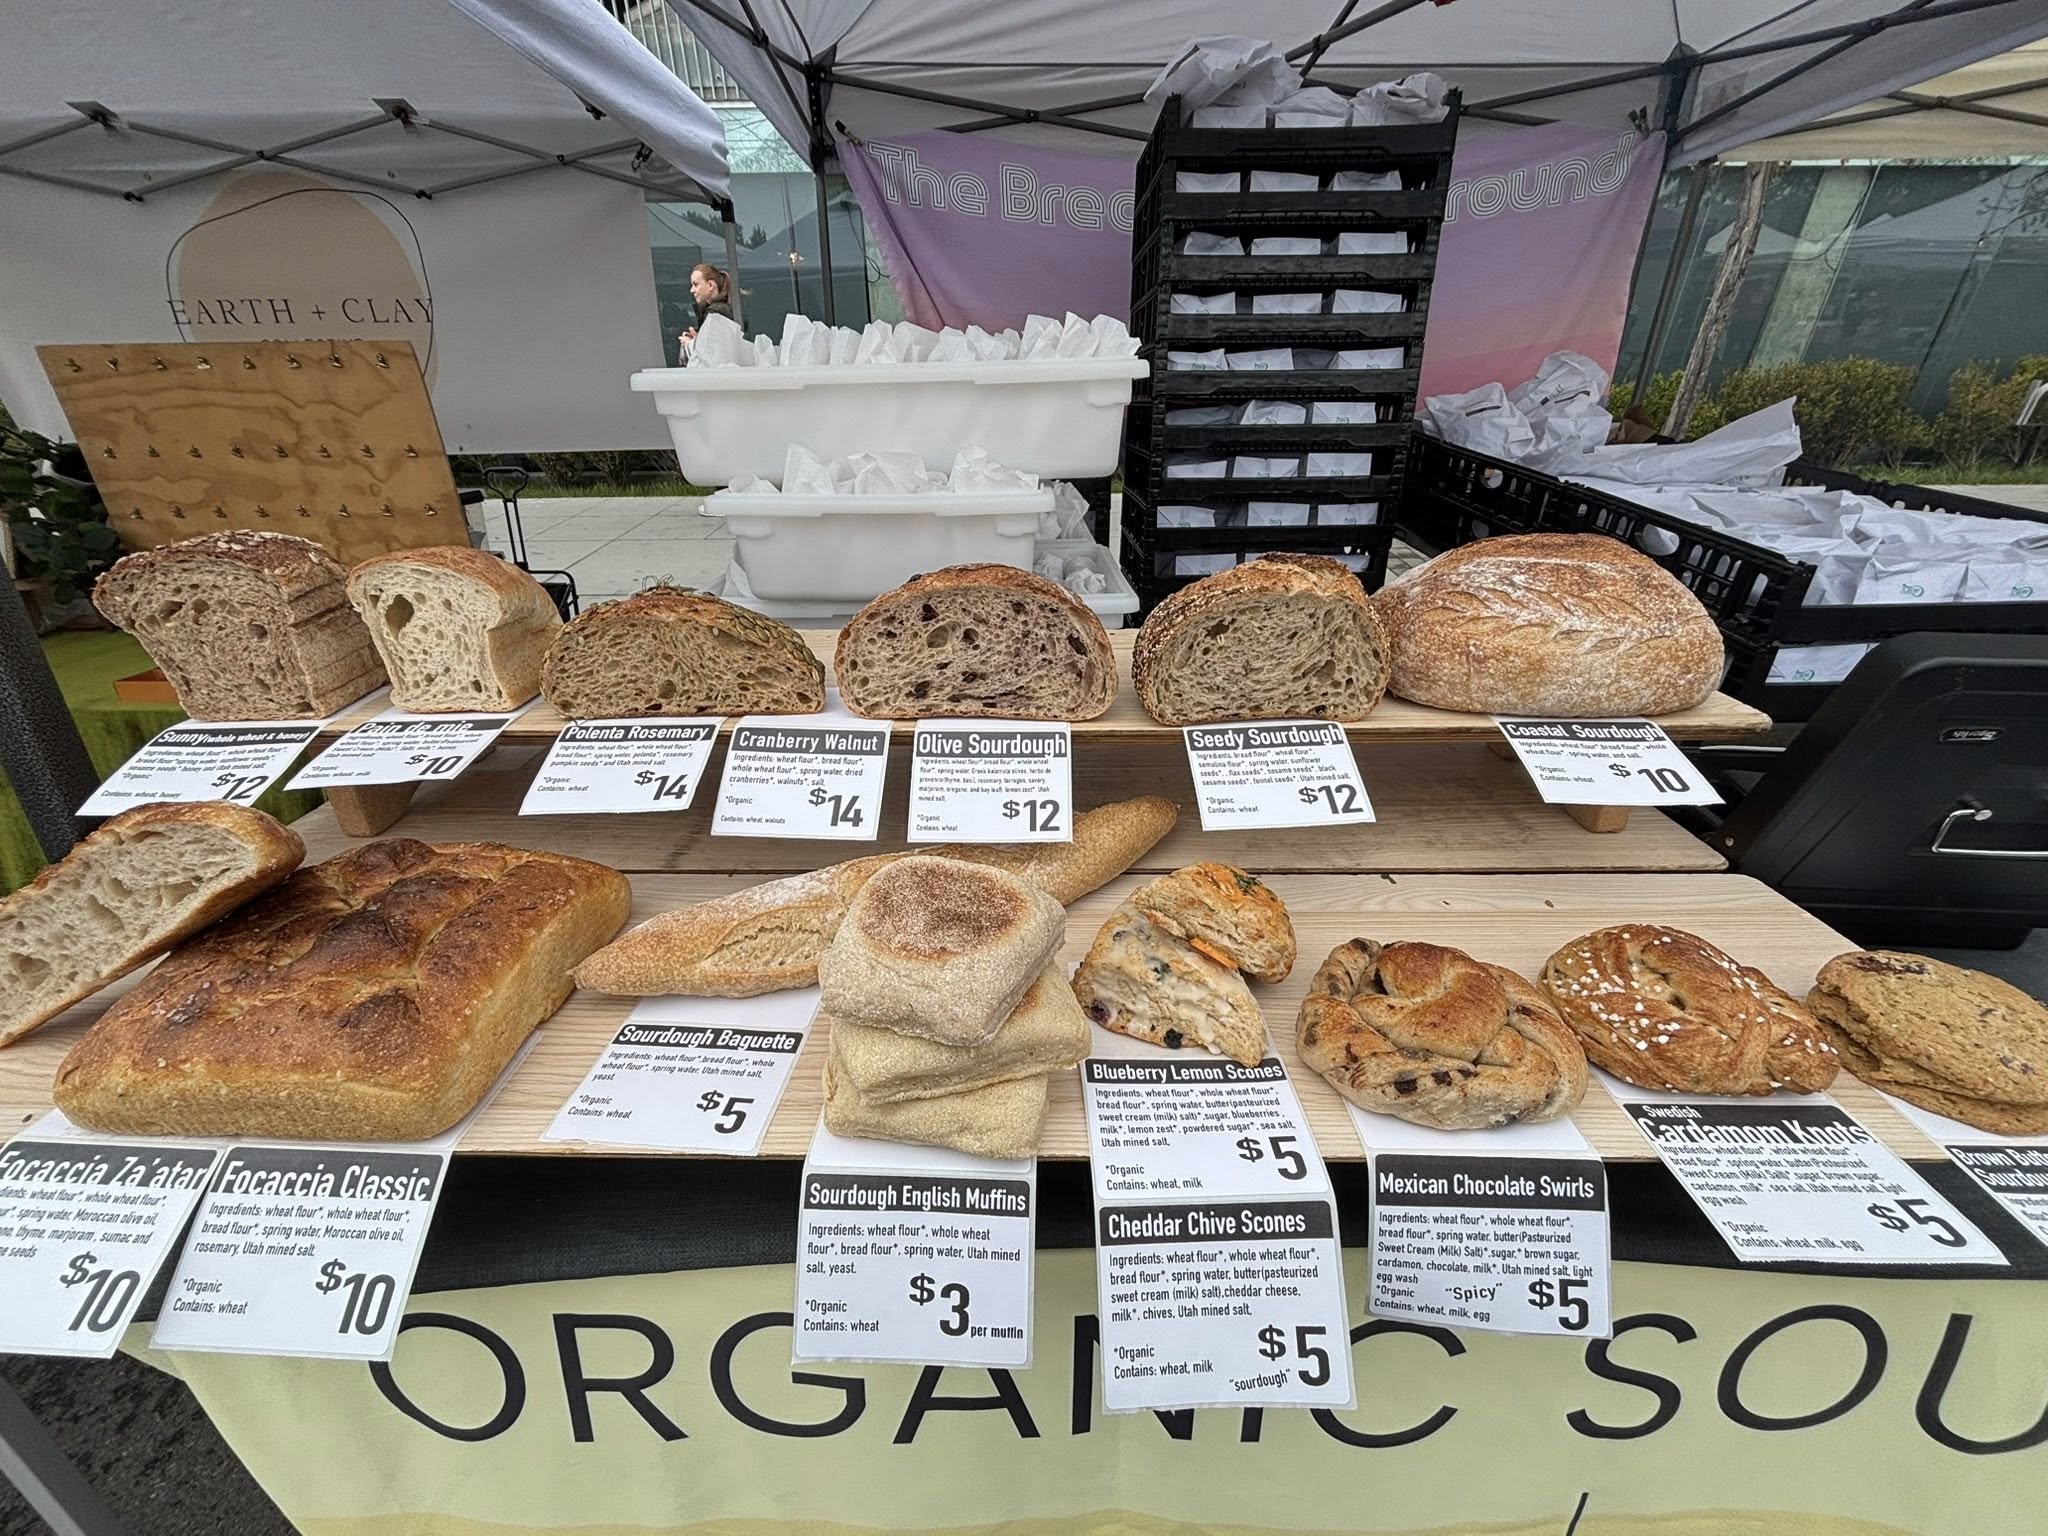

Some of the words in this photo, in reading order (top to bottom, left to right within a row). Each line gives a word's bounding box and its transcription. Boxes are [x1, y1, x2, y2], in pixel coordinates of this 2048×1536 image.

[867, 141, 988, 216] The
[168, 300, 295, 325] EARTH
[312, 304, 325, 320] +
[341, 298, 432, 324] CLAY
[237, 733, 264, 741] wheat
[357, 722, 402, 733] Pain
[406, 720, 428, 732] de
[438, 721, 474, 731] mie
[565, 727, 623, 739] Polenta
[628, 726, 709, 741] Rosemary
[1193, 730, 1244, 749] Seedy
[1250, 725, 1342, 745] Sourdough
[1506, 723, 1569, 738] Coastal
[1575, 725, 1665, 741] Sourdough
[739, 731, 819, 752] Cranberry
[825, 734, 878, 750] Walnut
[919, 734, 963, 754] Olive
[968, 734, 1065, 758] Sourdough
[405, 754, 464, 776] $10
[212, 773, 269, 800] $12
[634, 770, 688, 800] $14
[808, 787, 863, 827] $14
[1299, 784, 1364, 815] $12
[1002, 800, 1060, 832] $12
[619, 1026, 713, 1048] Sourdough
[717, 1030, 796, 1051] Baguette
[1093, 1063, 1167, 1083] Blueberry
[1170, 1065, 1223, 1080] Lemon
[1228, 1064, 1283, 1079] Scones
[568, 1106, 605, 1117] Contains:
[606, 1110, 632, 1119] wheat
[696, 1089, 755, 1134] $5
[1643, 1106, 1702, 1118] Swedish
[1638, 1117, 1787, 1144] Cardamom
[1781, 1119, 1873, 1144] Knots
[0, 1151, 108, 1185] Focaccia
[1236, 1135, 1308, 1181] $5
[1950, 1148, 2016, 1166] Brown
[221, 1160, 334, 1198] Focaccia
[340, 1165, 430, 1200] Classic
[1107, 1180, 1148, 1191] Contains:
[1150, 1178, 1181, 1189] wheat,
[1183, 1178, 1203, 1188] milk
[1380, 1173, 1448, 1194] Mexican
[1453, 1174, 1536, 1196] Chocolate
[1540, 1176, 1595, 1198] Swirls
[810, 1183, 896, 1210] Sourdough
[902, 1185, 960, 1211] English
[966, 1188, 1026, 1211] Muffins
[1108, 1213, 1182, 1239] Cheddar
[1188, 1211, 1236, 1234] Chive
[1241, 1210, 1306, 1233] Scones
[1380, 1212, 1430, 1225] Ingredients:
[1433, 1213, 1458, 1224] wheat
[1490, 1215, 1515, 1226] whole
[1518, 1215, 1543, 1227] wheat
[1867, 1199, 1967, 1248] $5
[808, 1223, 864, 1238] Ingredients:
[868, 1225, 896, 1236] wheat
[931, 1226, 959, 1239] whole
[962, 1228, 990, 1240] wheat
[1379, 1228, 1403, 1238] bread
[1436, 1231, 1463, 1243] spring
[841, 1243, 868, 1255] bread
[904, 1244, 933, 1259] spring
[937, 1246, 965, 1259] water,
[967, 1247, 988, 1259] Utah
[991, 1248, 1020, 1261] mined
[1110, 1254, 1164, 1268] Ingredients:
[1166, 1251, 1195, 1263] wheat
[1229, 1250, 1256, 1262] whole
[1259, 1249, 1287, 1261] wheat
[806, 1262, 826, 1274] salt,
[1110, 1272, 1136, 1285] bread
[1172, 1270, 1201, 1284] spring
[1376, 1274, 1392, 1284] egg
[1395, 1273, 1418, 1284] wash
[1502, 1264, 1521, 1275] Utah
[1523, 1264, 1549, 1276] mined
[1573, 1265, 1593, 1279] light
[60, 1251, 140, 1332] $10
[316, 1258, 396, 1335] $10
[1111, 1291, 1138, 1304] sweet
[1141, 1290, 1169, 1302] cream
[1173, 1286, 1199, 1300] (milk)
[173, 1298, 216, 1314] Contains:
[218, 1301, 248, 1314] wheat
[909, 1273, 970, 1337] $3
[971, 1327, 988, 1338] per
[991, 1327, 1023, 1339] muffin
[1178, 1304, 1198, 1318] Utah
[1201, 1303, 1230, 1316] mined
[1375, 1299, 1415, 1312] Contains:
[1474, 1312, 1490, 1322] egg
[1528, 1278, 1589, 1330] $5
[804, 1319, 847, 1332] Contains:
[850, 1319, 879, 1332] wheat
[1258, 1325, 1330, 1386] $5
[368, 1310, 1467, 1449] ORGAC
[1114, 1365, 1157, 1379] Contains:
[1159, 1362, 1190, 1377] wheat,
[1193, 1360, 1213, 1373] milk
